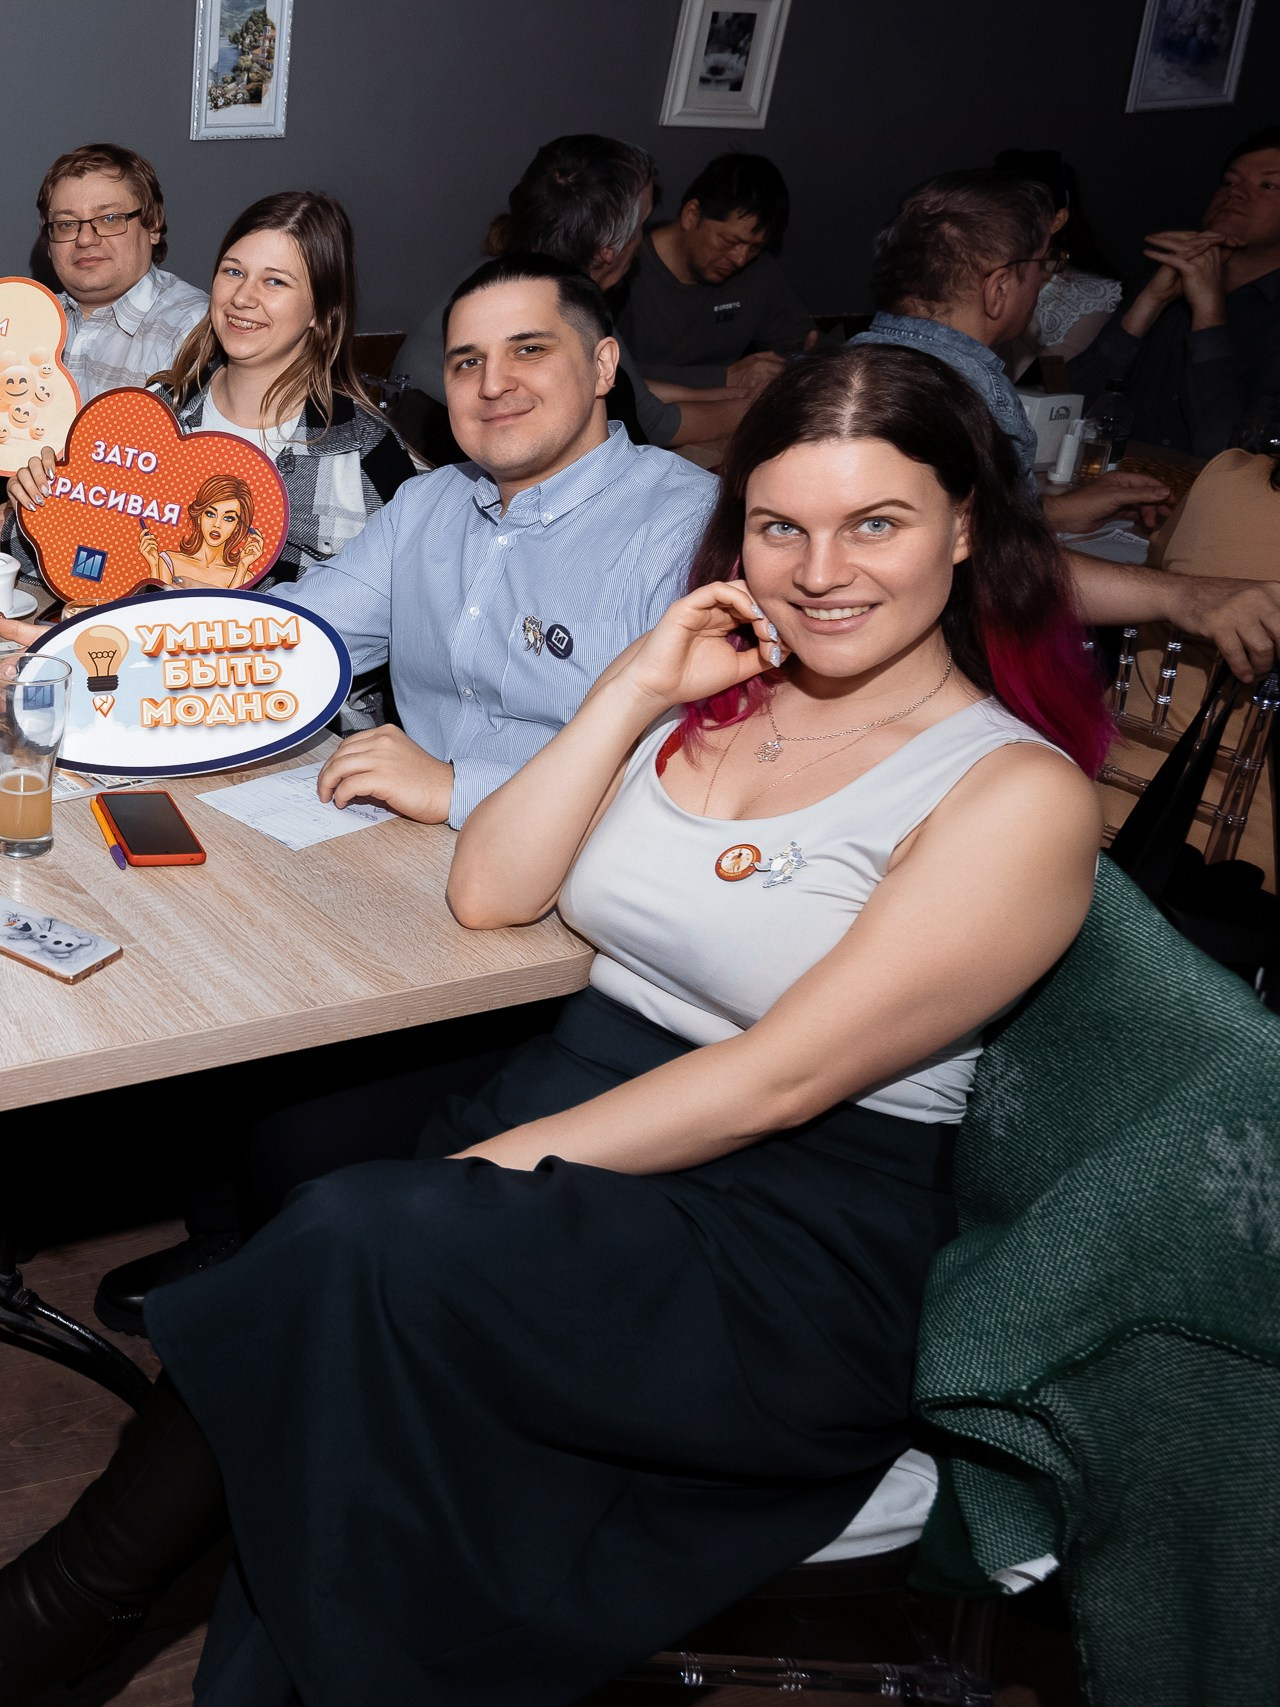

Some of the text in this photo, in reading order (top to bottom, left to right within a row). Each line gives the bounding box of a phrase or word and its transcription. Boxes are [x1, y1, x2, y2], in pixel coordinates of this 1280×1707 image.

[91, 440, 158, 473] ЗАТО
[135, 616, 301, 657] УМНЫМ
[163, 654, 282, 690] БЫТЬ
[140, 690, 298, 728] МОДНО
